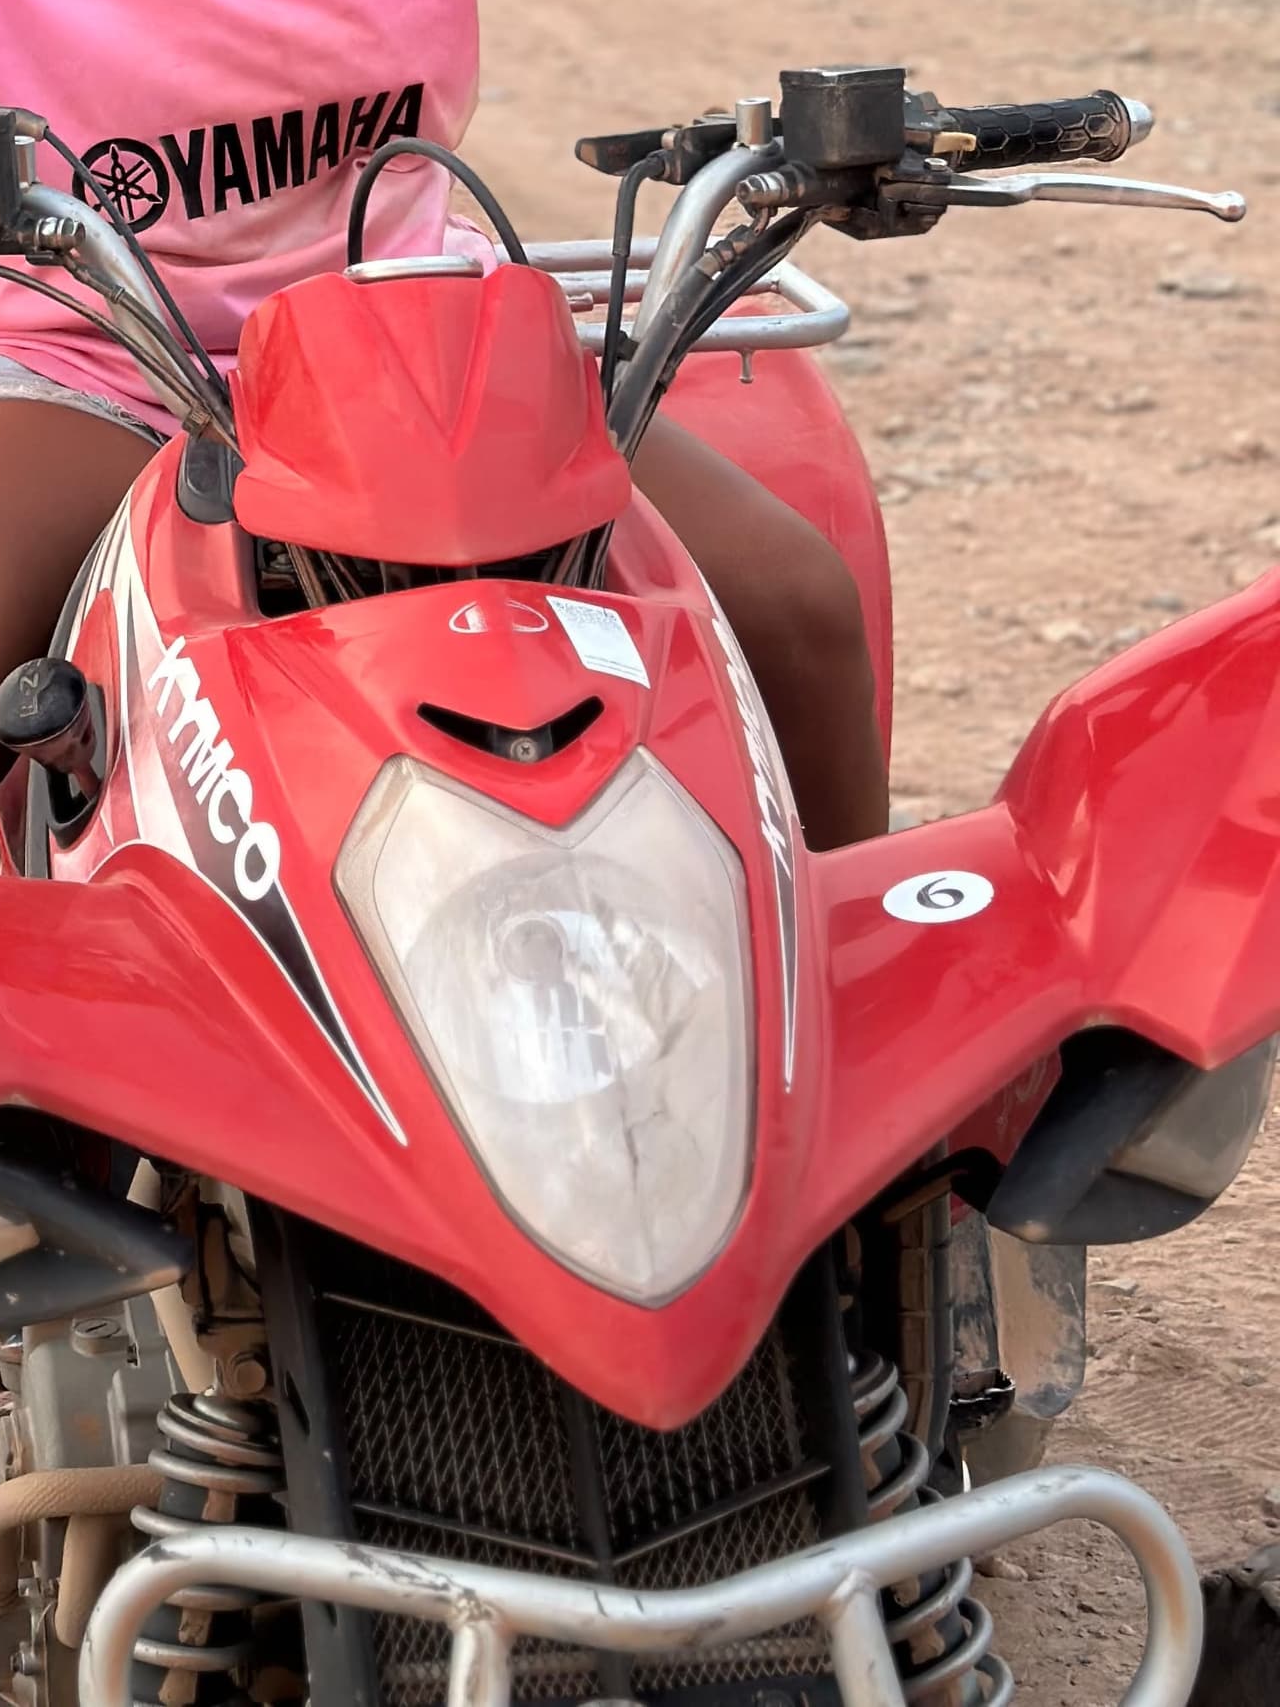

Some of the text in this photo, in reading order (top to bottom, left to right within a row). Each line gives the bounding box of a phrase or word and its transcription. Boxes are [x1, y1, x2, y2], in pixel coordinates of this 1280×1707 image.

[159, 82, 425, 221] YAMAHA
[147, 635, 281, 901] KYMCO
[916, 877, 964, 909] 6
